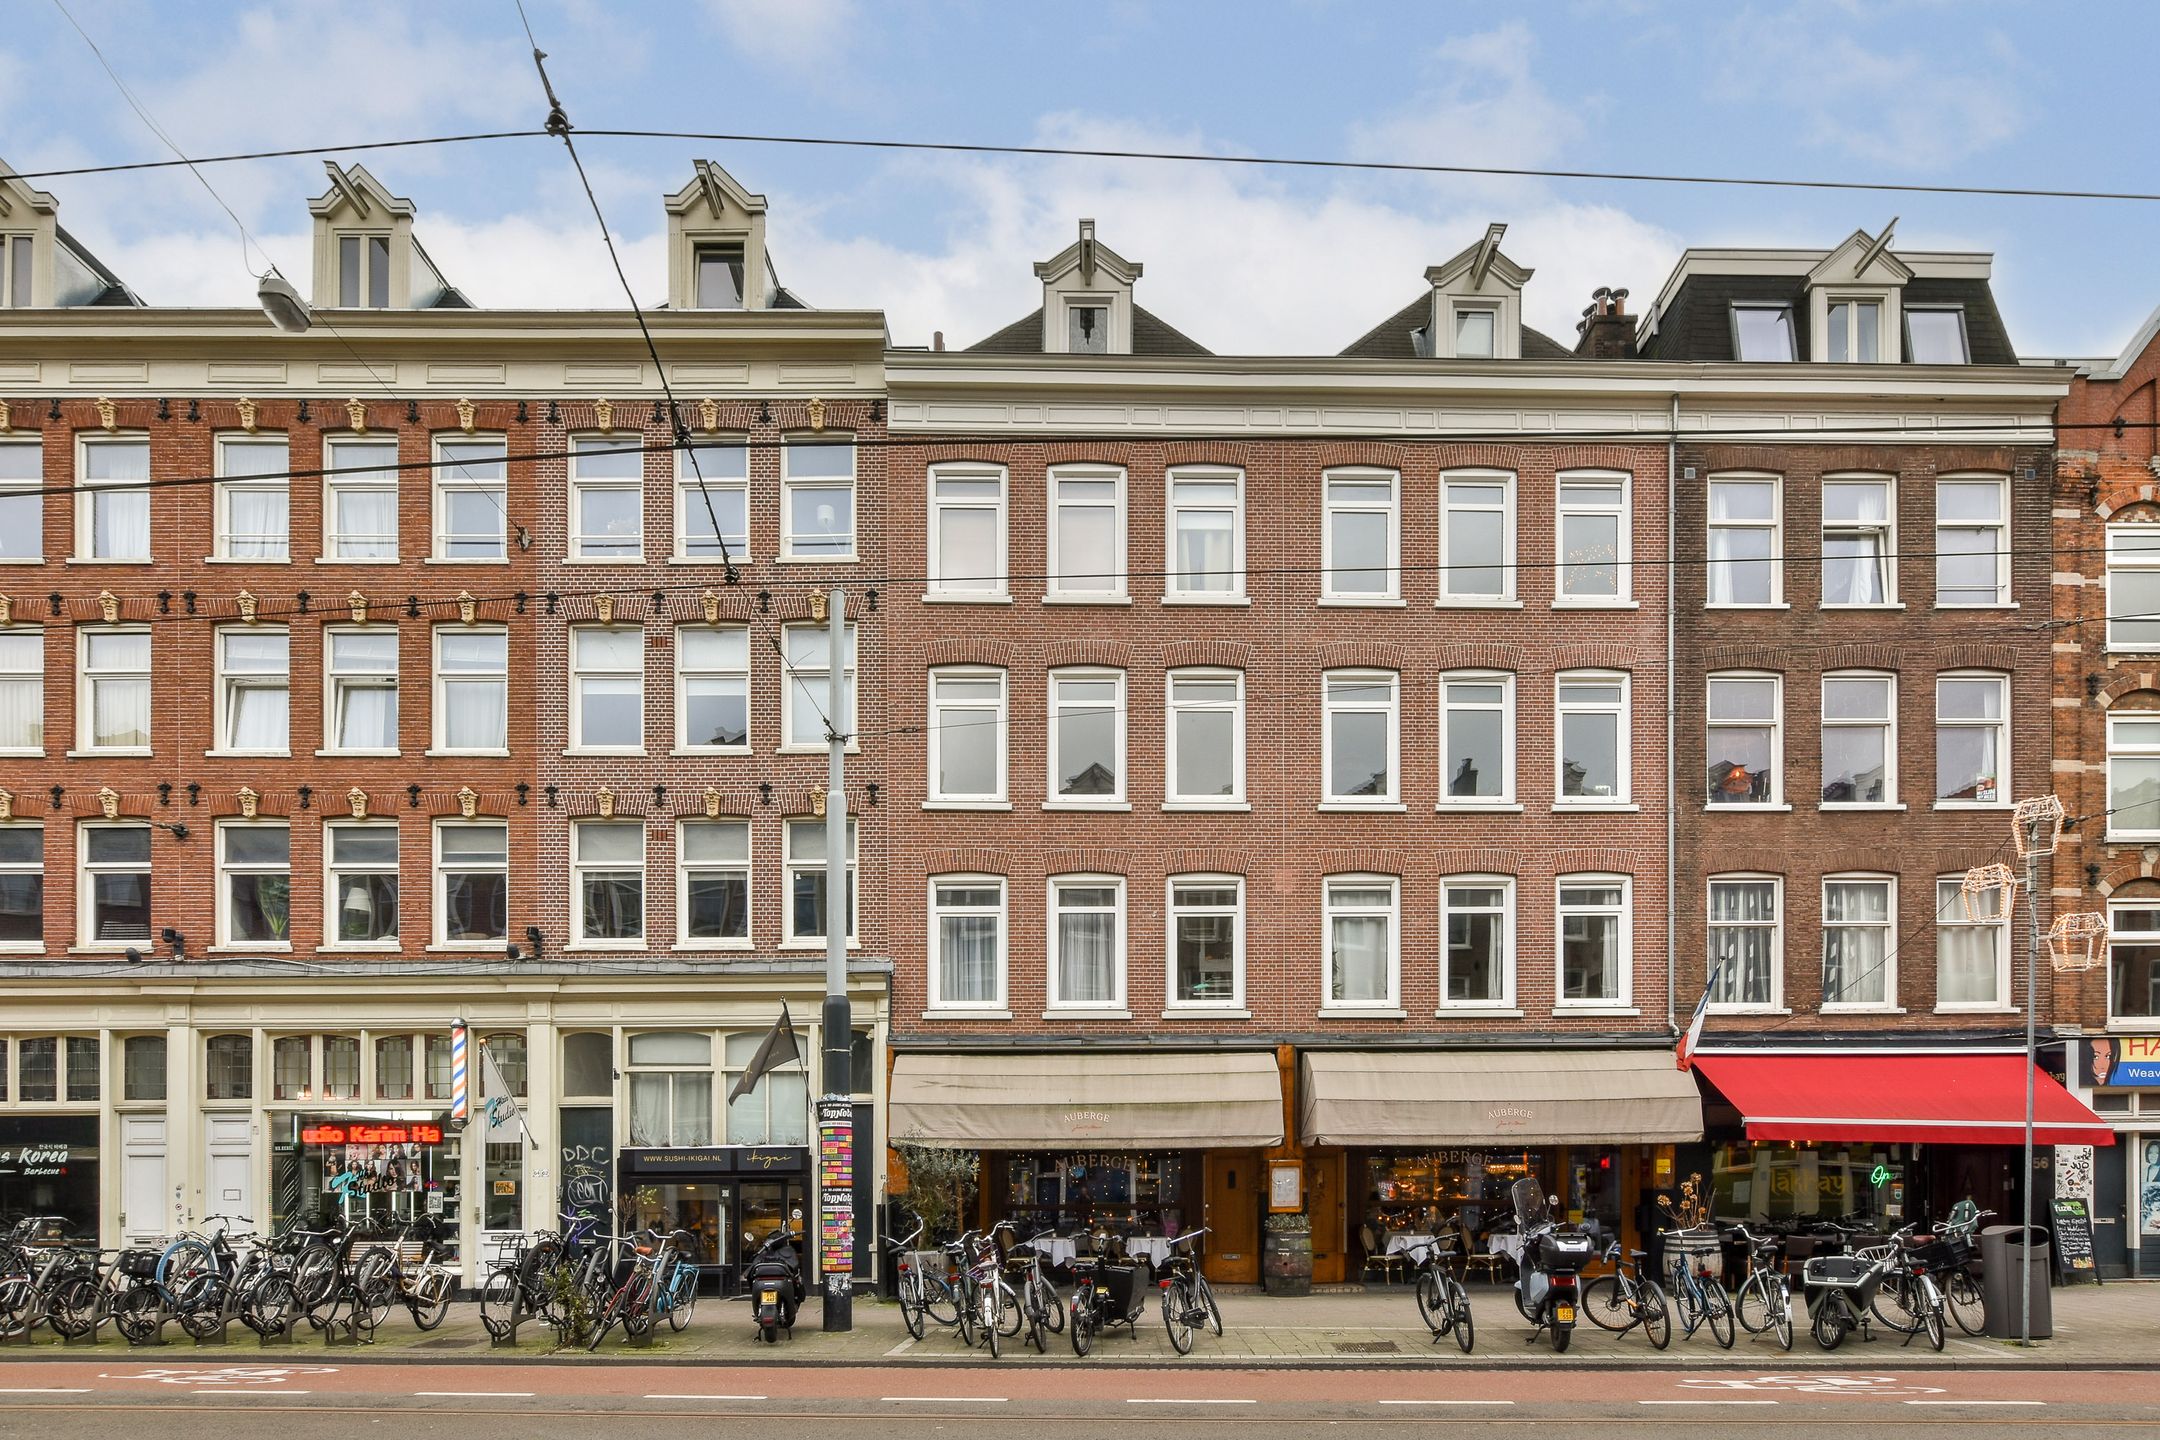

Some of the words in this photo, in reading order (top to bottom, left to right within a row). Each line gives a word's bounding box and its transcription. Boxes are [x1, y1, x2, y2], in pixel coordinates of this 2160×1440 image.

[492, 1105, 516, 1128] Studio
[1064, 1111, 1110, 1122] AUBERGE
[1488, 1108, 1533, 1119] AUBERGE
[350, 1126, 407, 1142] Karim
[412, 1126, 440, 1142] Ha
[0, 1151, 11, 1162] s
[18, 1147, 68, 1166] Korea
[562, 1145, 609, 1164] DDC
[643, 1154, 722, 1162] WWW.SUSHI-IKIGAI.NL
[746, 1149, 792, 1169] ikigai
[1055, 1153, 1132, 1173] AUBERGE
[1416, 1150, 1494, 1168] AUBERGE
[347, 1173, 396, 1198] Studio
